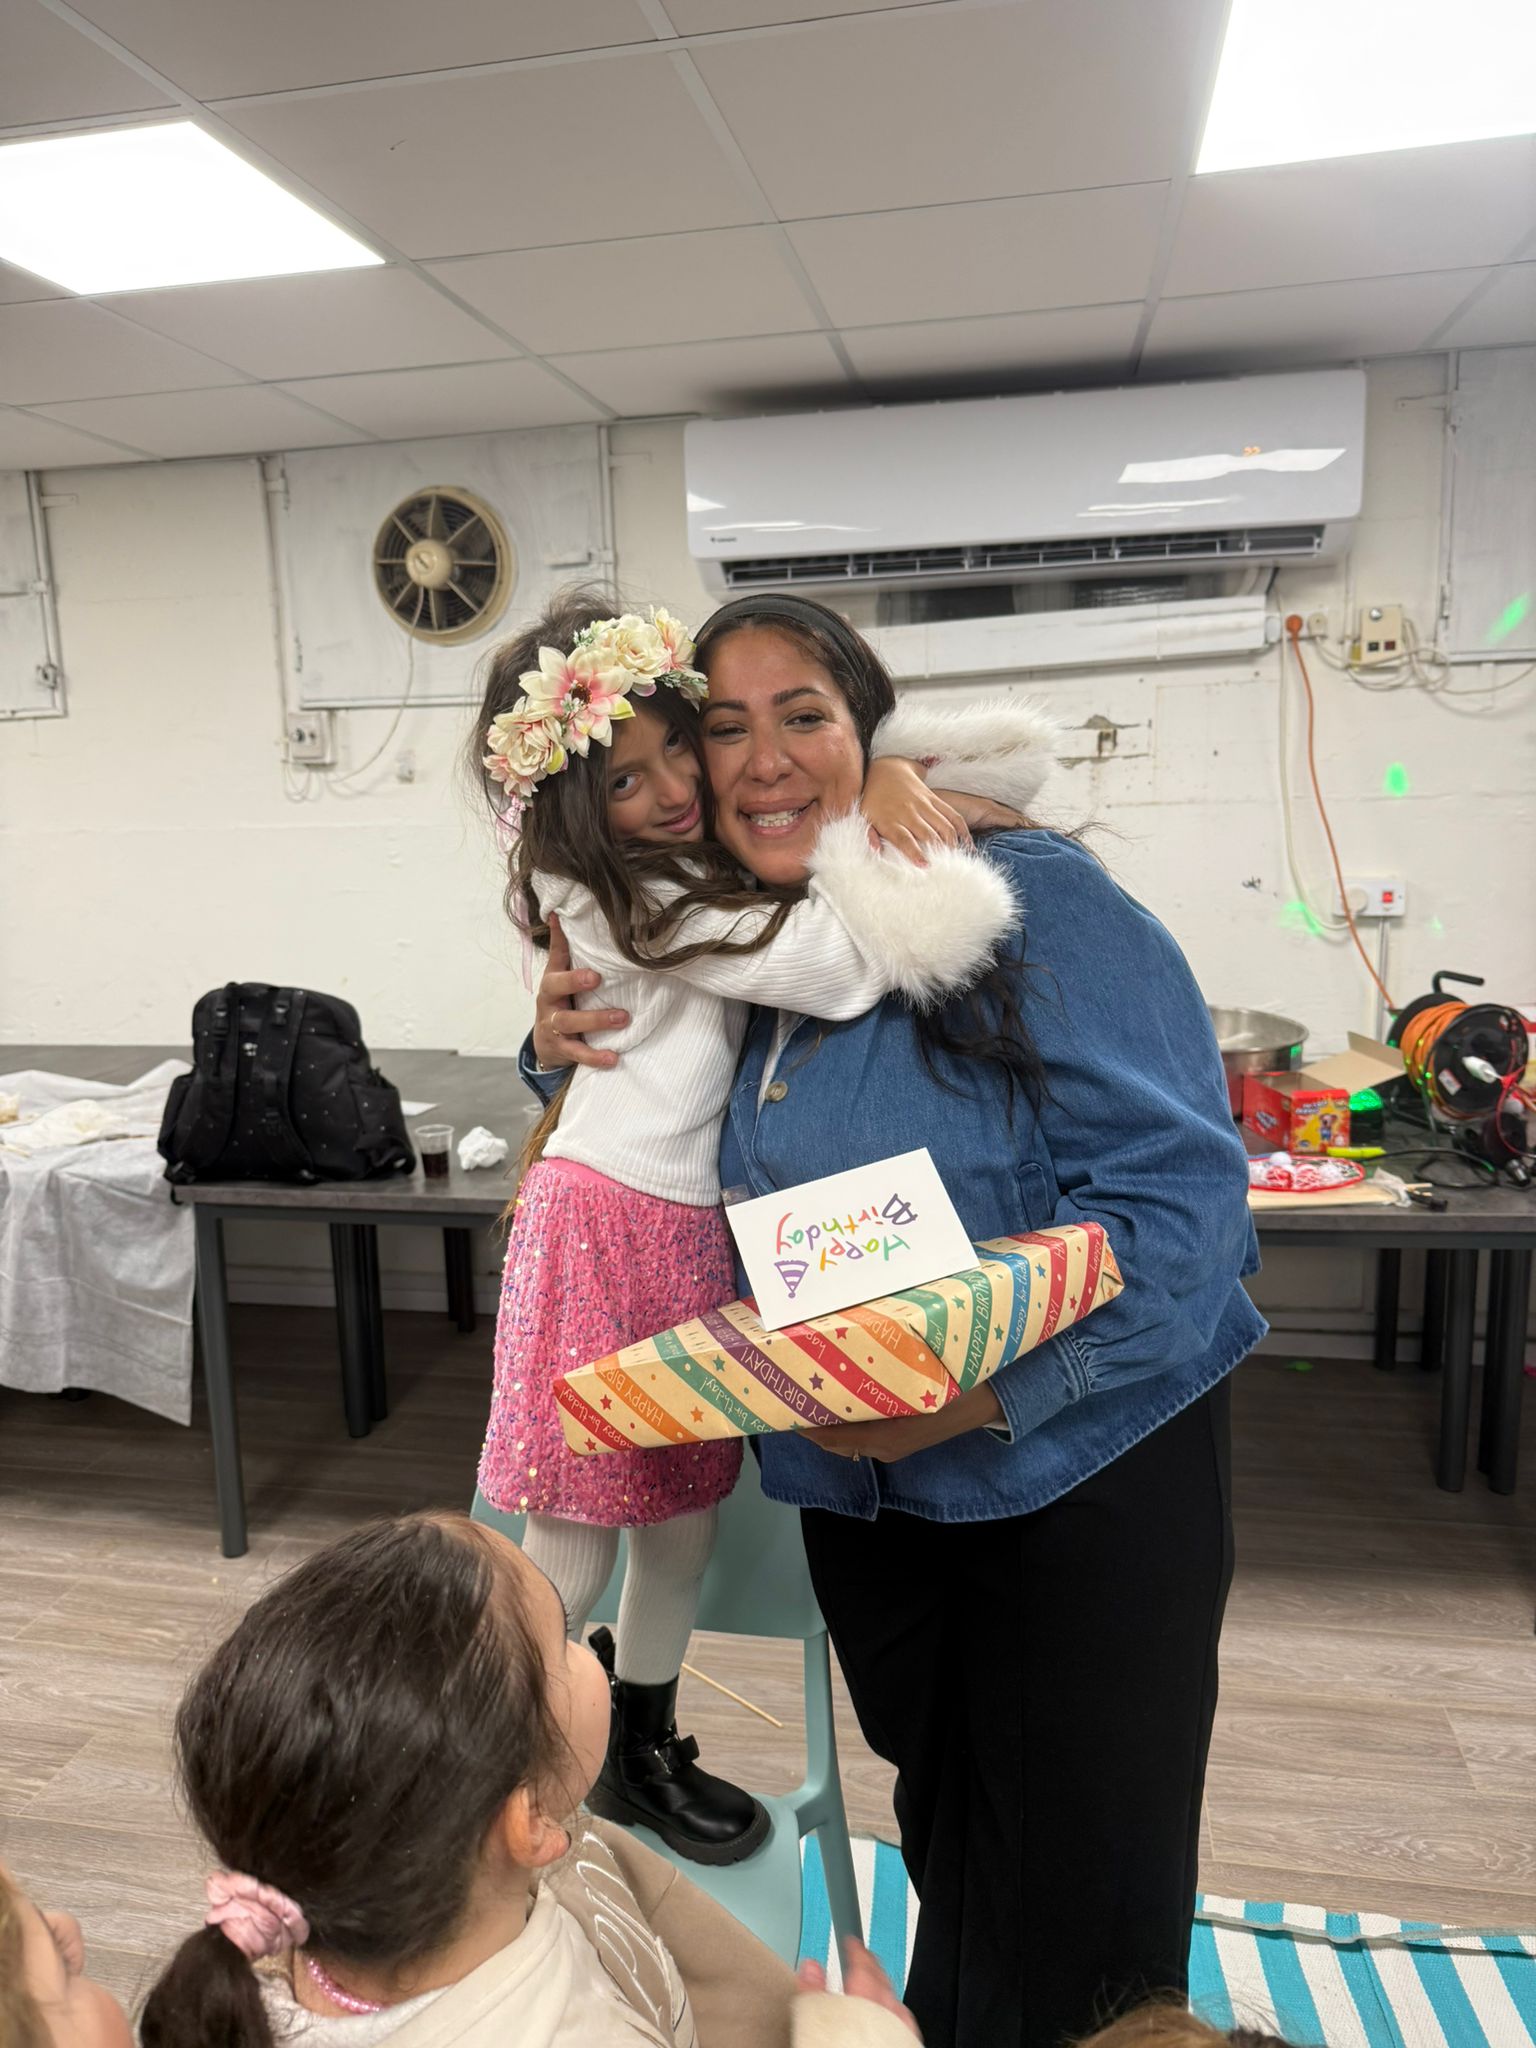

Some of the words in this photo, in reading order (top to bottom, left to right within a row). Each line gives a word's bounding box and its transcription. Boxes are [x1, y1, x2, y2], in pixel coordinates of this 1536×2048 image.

[776, 1193, 918, 1255] Birthday
[820, 1234, 911, 1272] Happy
[967, 1319, 987, 1377] HAPPY
[1010, 1305, 1026, 1344] happy
[699, 1377, 748, 1427] birthday!
[739, 1346, 808, 1412] BIRTHDAY!
[559, 1386, 601, 1433] birthday!
[624, 1384, 664, 1427] HAPPY
